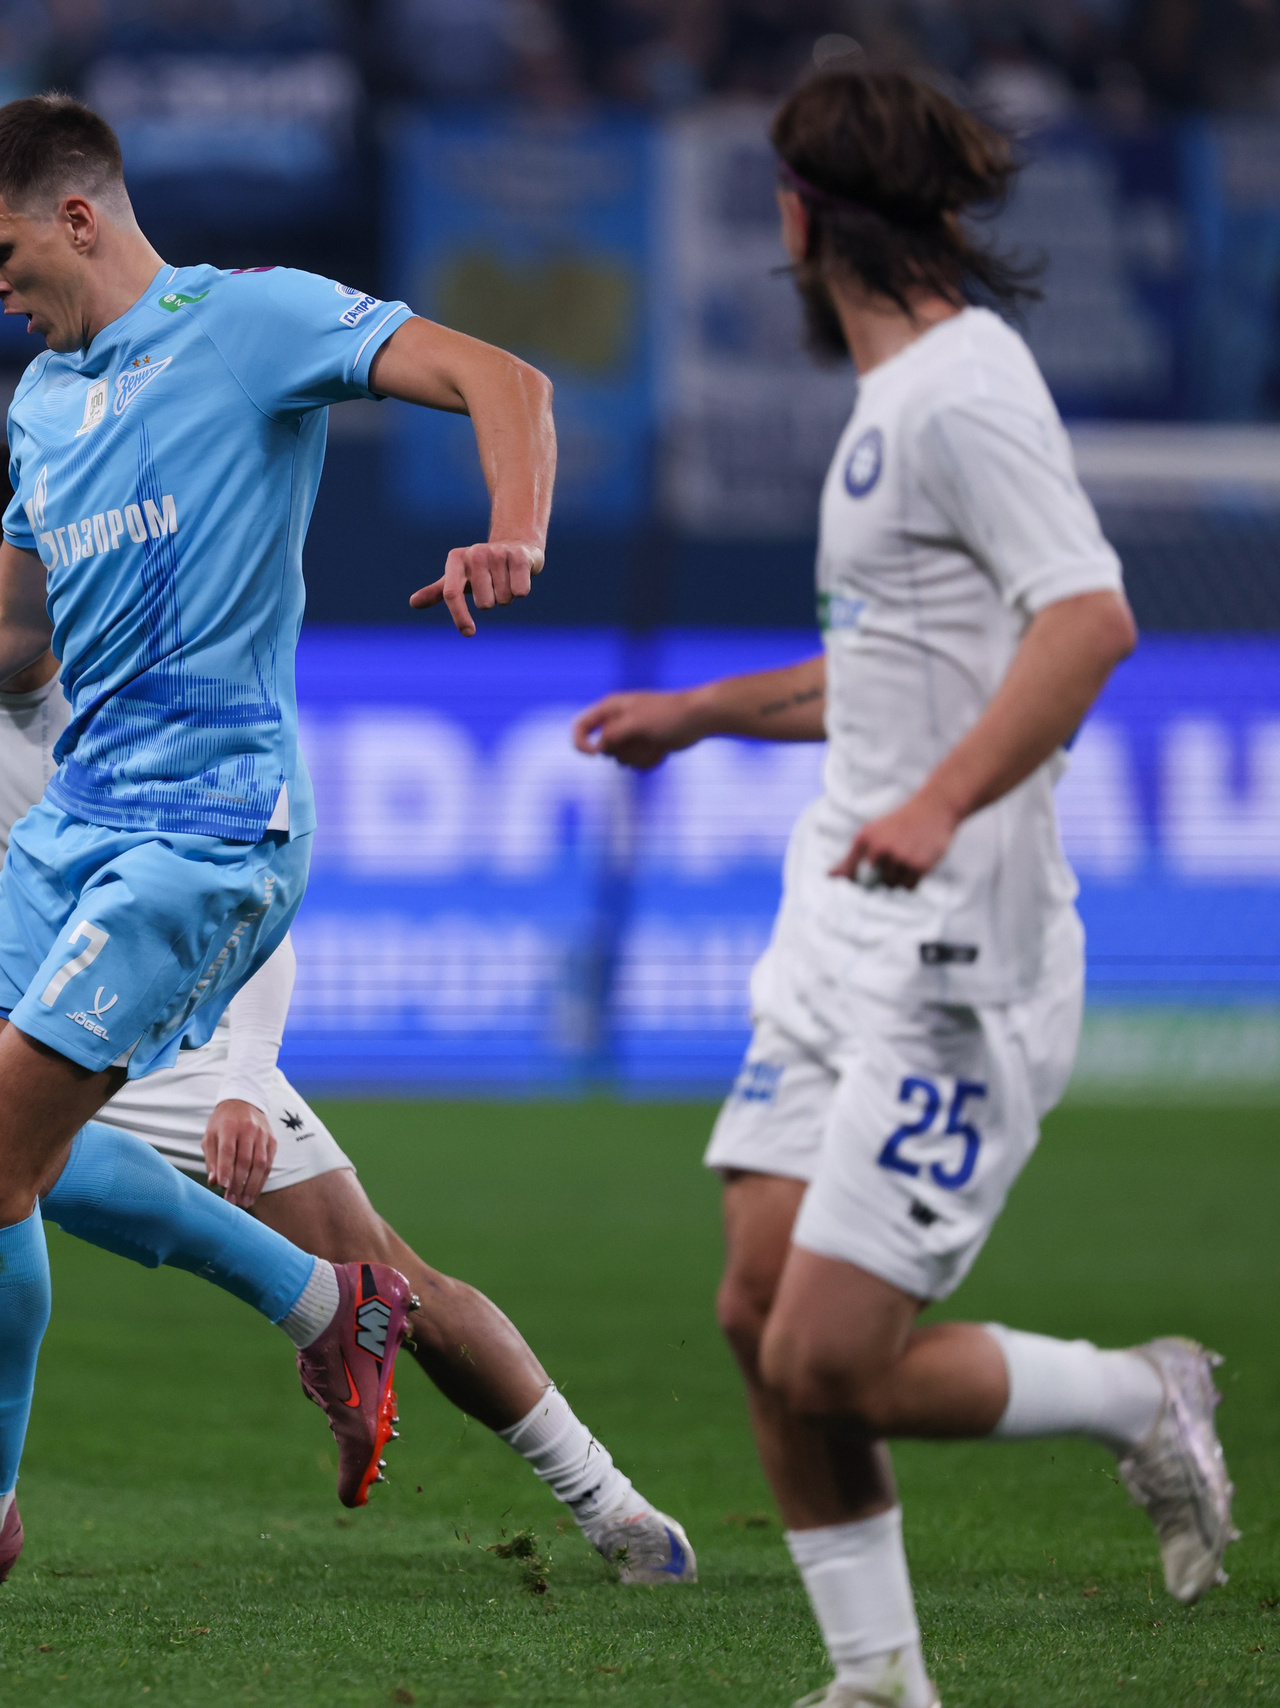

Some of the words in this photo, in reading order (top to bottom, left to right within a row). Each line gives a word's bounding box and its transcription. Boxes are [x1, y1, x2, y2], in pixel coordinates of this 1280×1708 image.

[54, 494, 178, 567] ГАЗПРОМ
[40, 920, 110, 1008] 7
[65, 1012, 110, 1041] JÖGEL
[877, 1076, 987, 1190] 25
